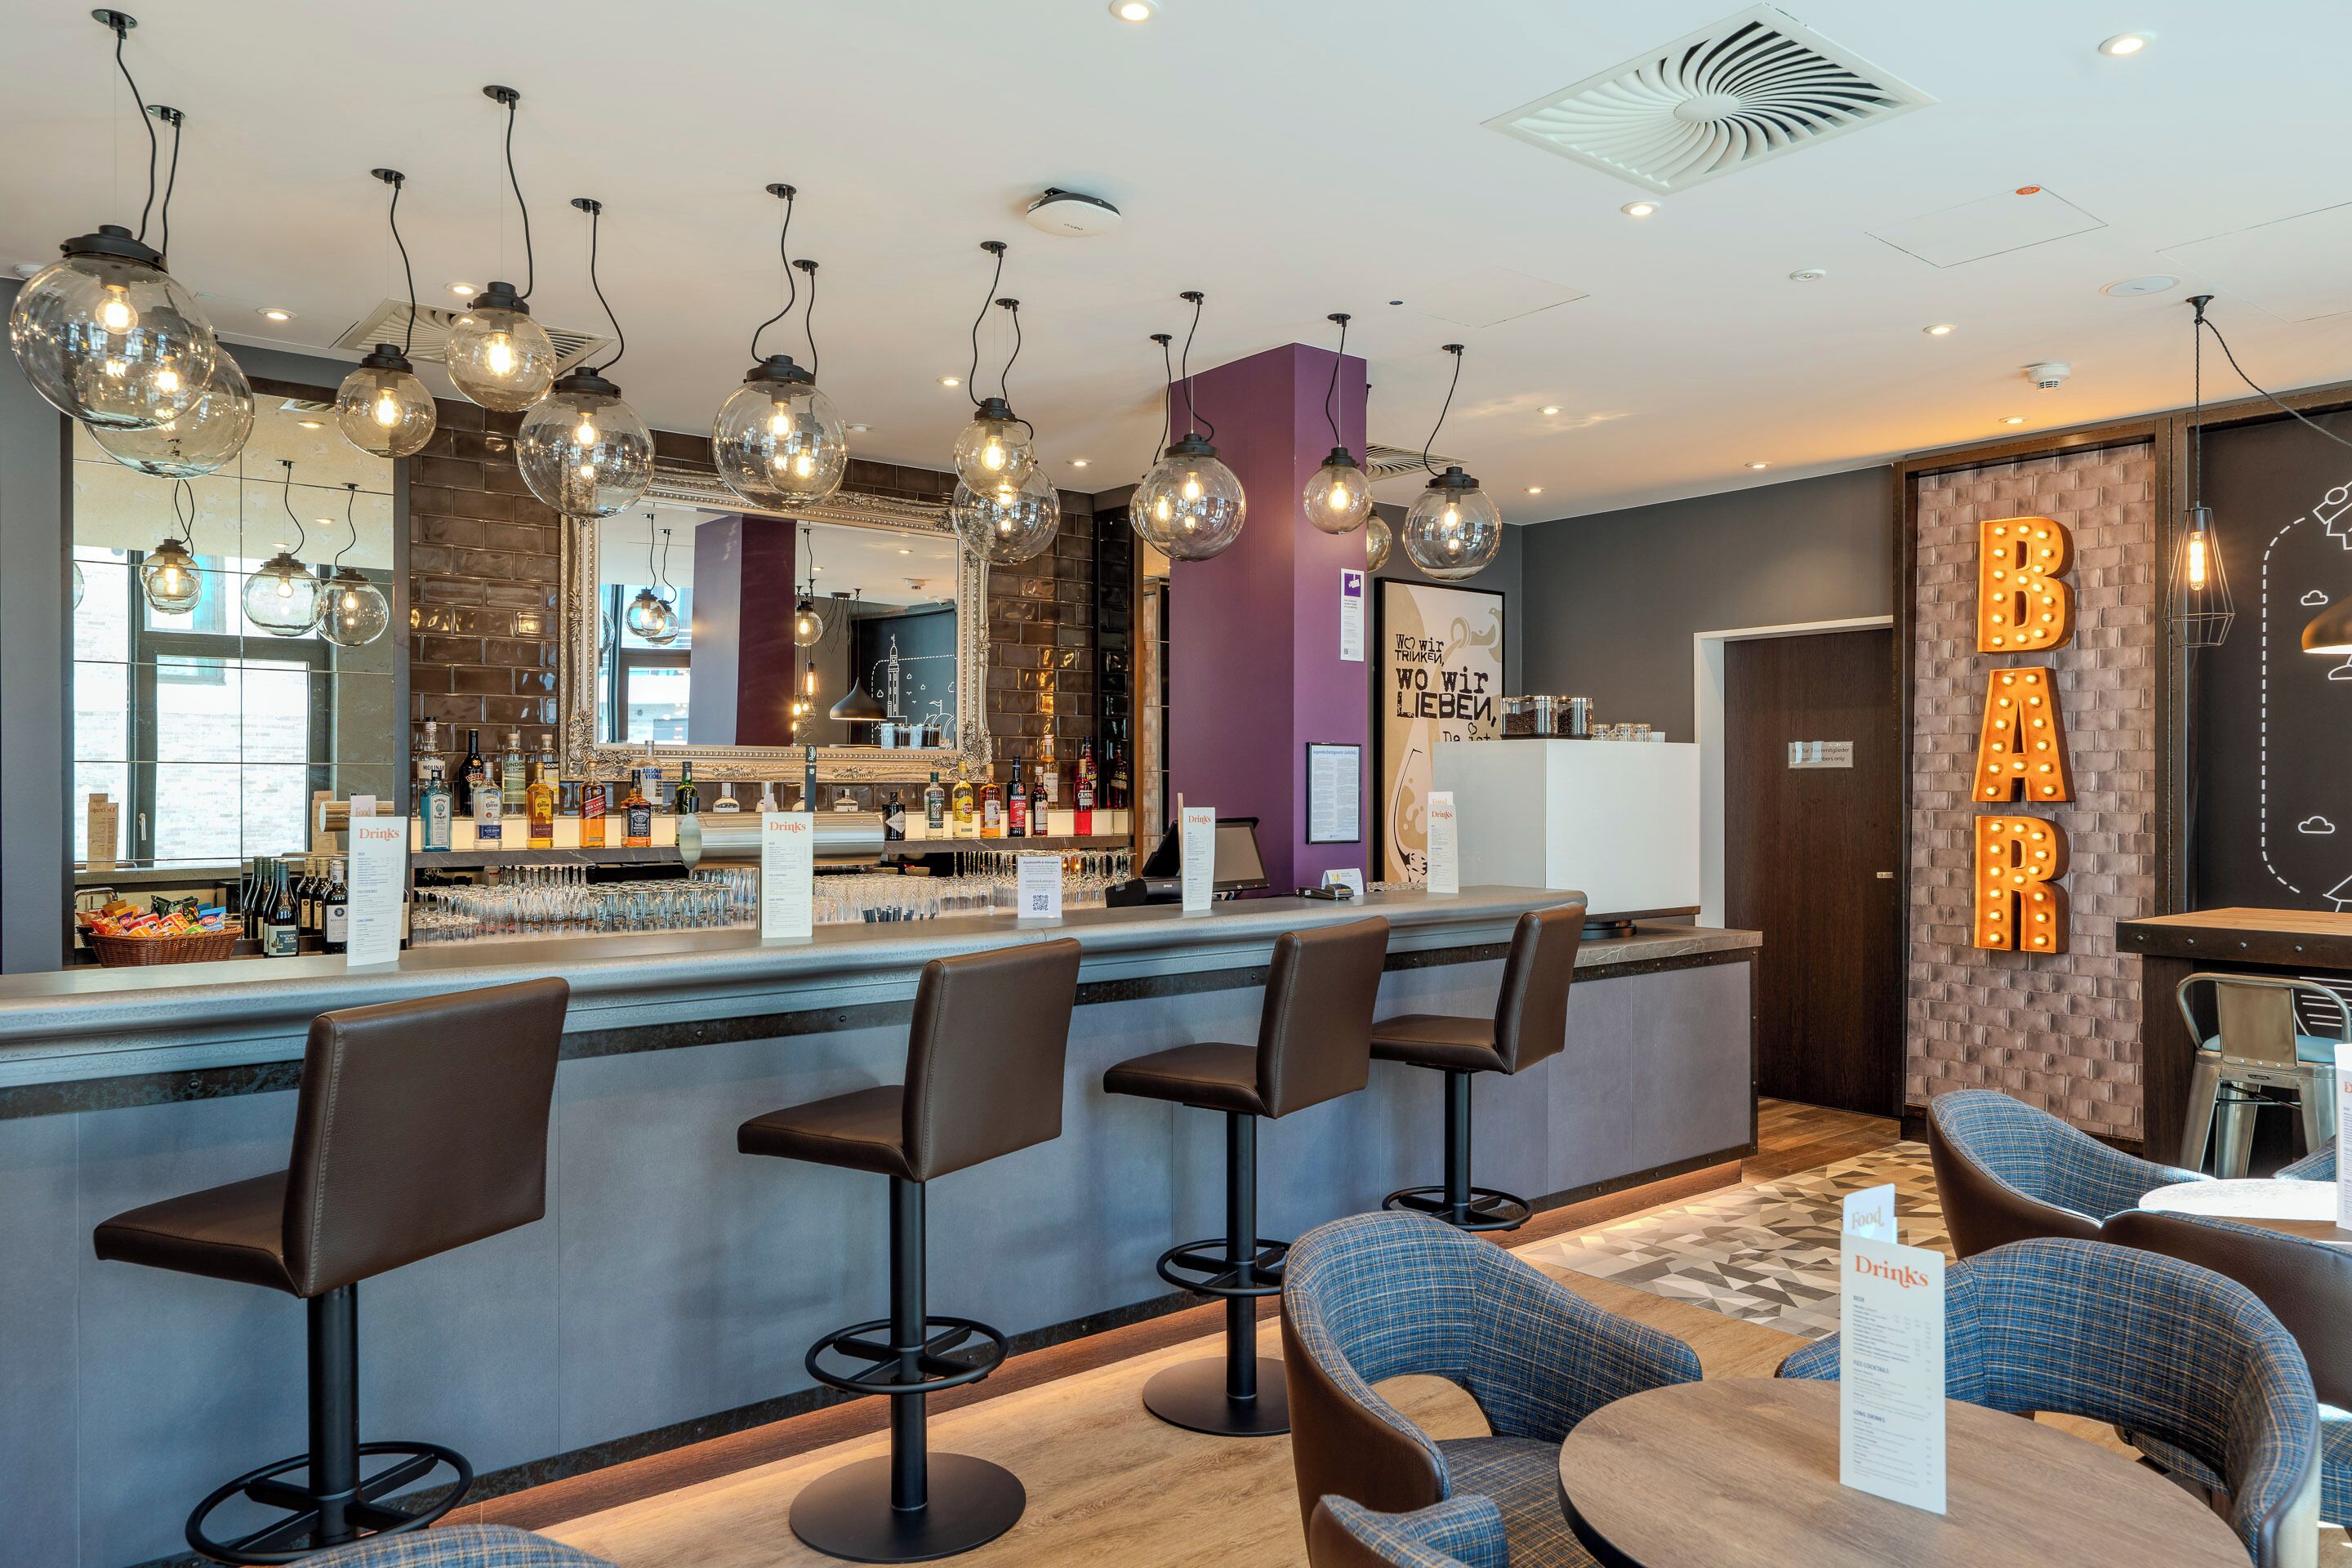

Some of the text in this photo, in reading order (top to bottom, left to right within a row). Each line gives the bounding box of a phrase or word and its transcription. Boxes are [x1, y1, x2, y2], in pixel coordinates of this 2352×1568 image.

[1419, 637, 1444, 653] wir
[1441, 666, 1489, 694] wir
[1397, 691, 1497, 727] LIEBEN,
[1977, 517, 2075, 954] BAR
[1188, 815, 1211, 825] Drinks
[1432, 811, 1453, 819] Drinks
[359, 827, 399, 841] Drinks
[770, 821, 806, 834] Drinks
[1851, 1205, 1885, 1230] Food
[1855, 1254, 1929, 1289] Drinks
